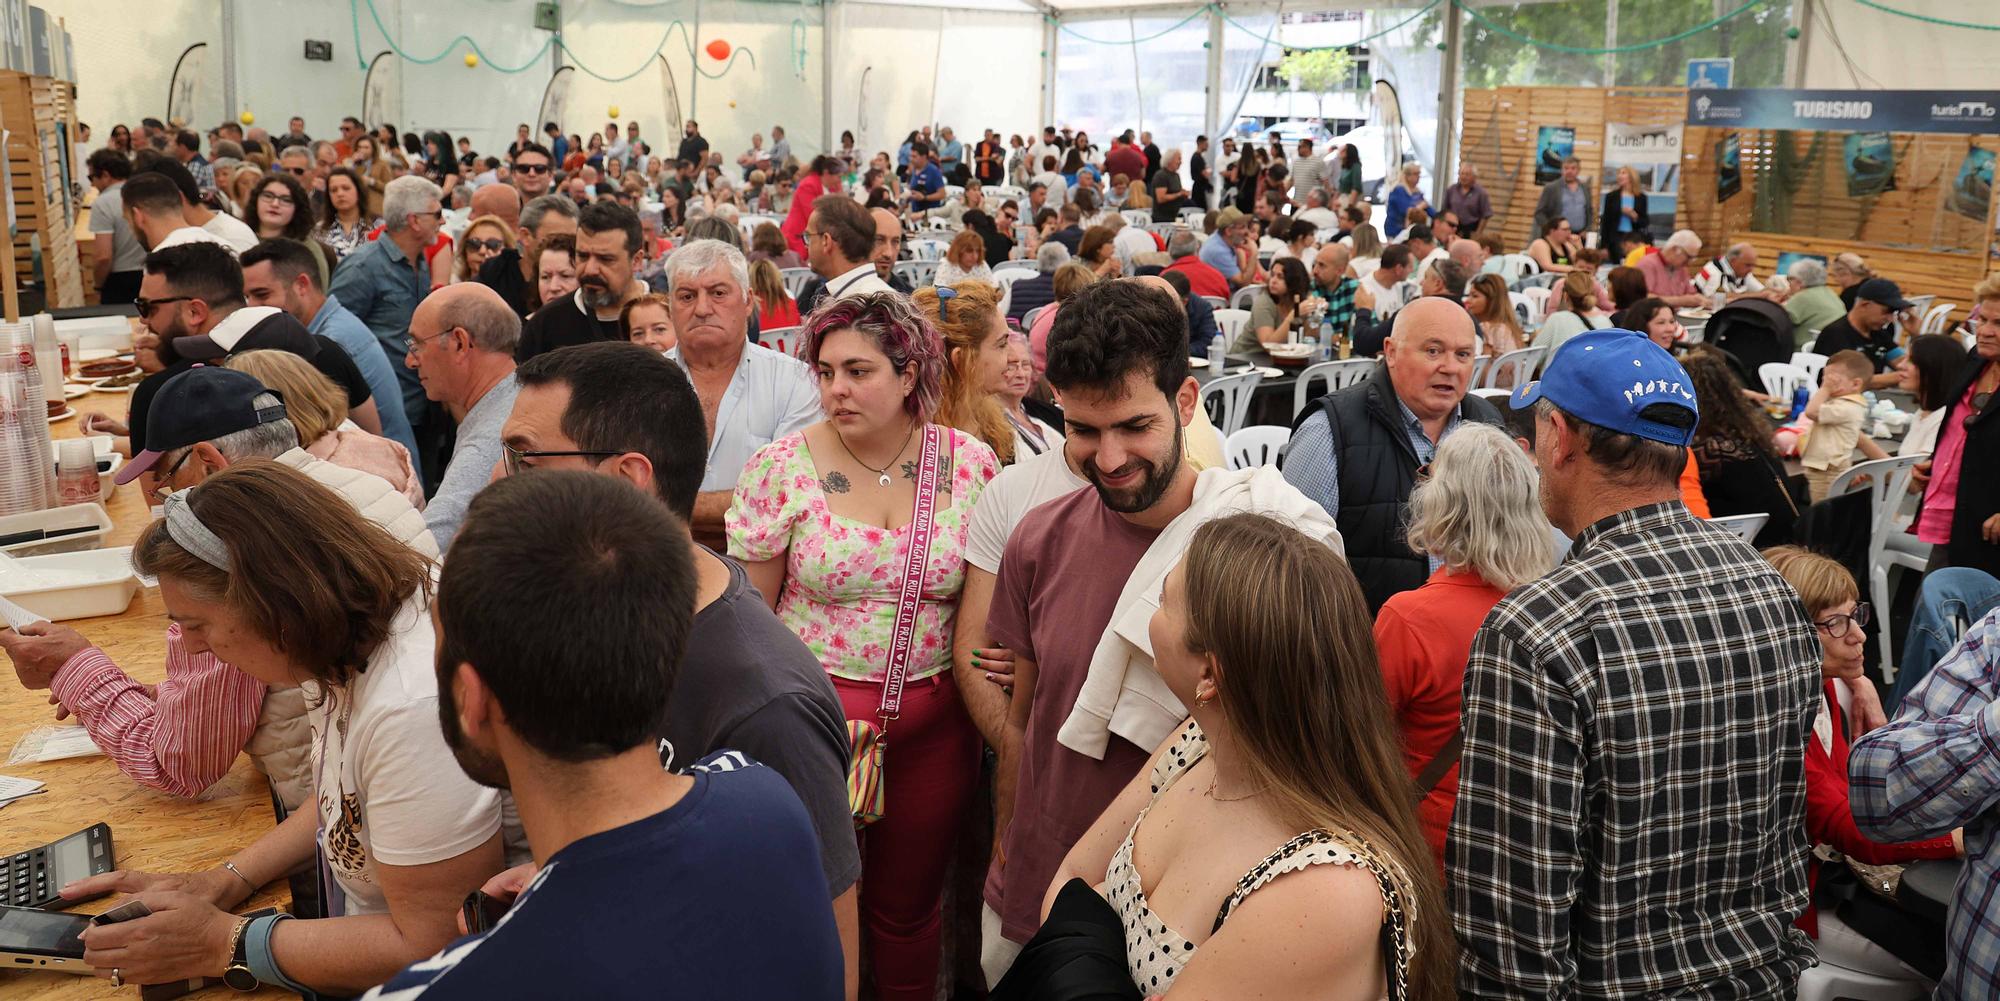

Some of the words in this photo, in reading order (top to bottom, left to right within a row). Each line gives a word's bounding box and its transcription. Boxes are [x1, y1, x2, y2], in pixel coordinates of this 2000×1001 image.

[1793, 101, 1872, 119] TURISMO
[925, 440, 935, 467] AGATHA
[923, 470, 932, 486] RUIZ
[921, 488, 930, 497] DE
[919, 499, 929, 508] LA
[917, 510, 928, 532] PRADA
[910, 543, 922, 576] AGATHA
[906, 580, 918, 598] RUIZ
[904, 601, 914, 611] DE
[901, 613, 911, 624] LA
[896, 626, 909, 651] PRADA
[889, 663, 902, 696] AGATHA
